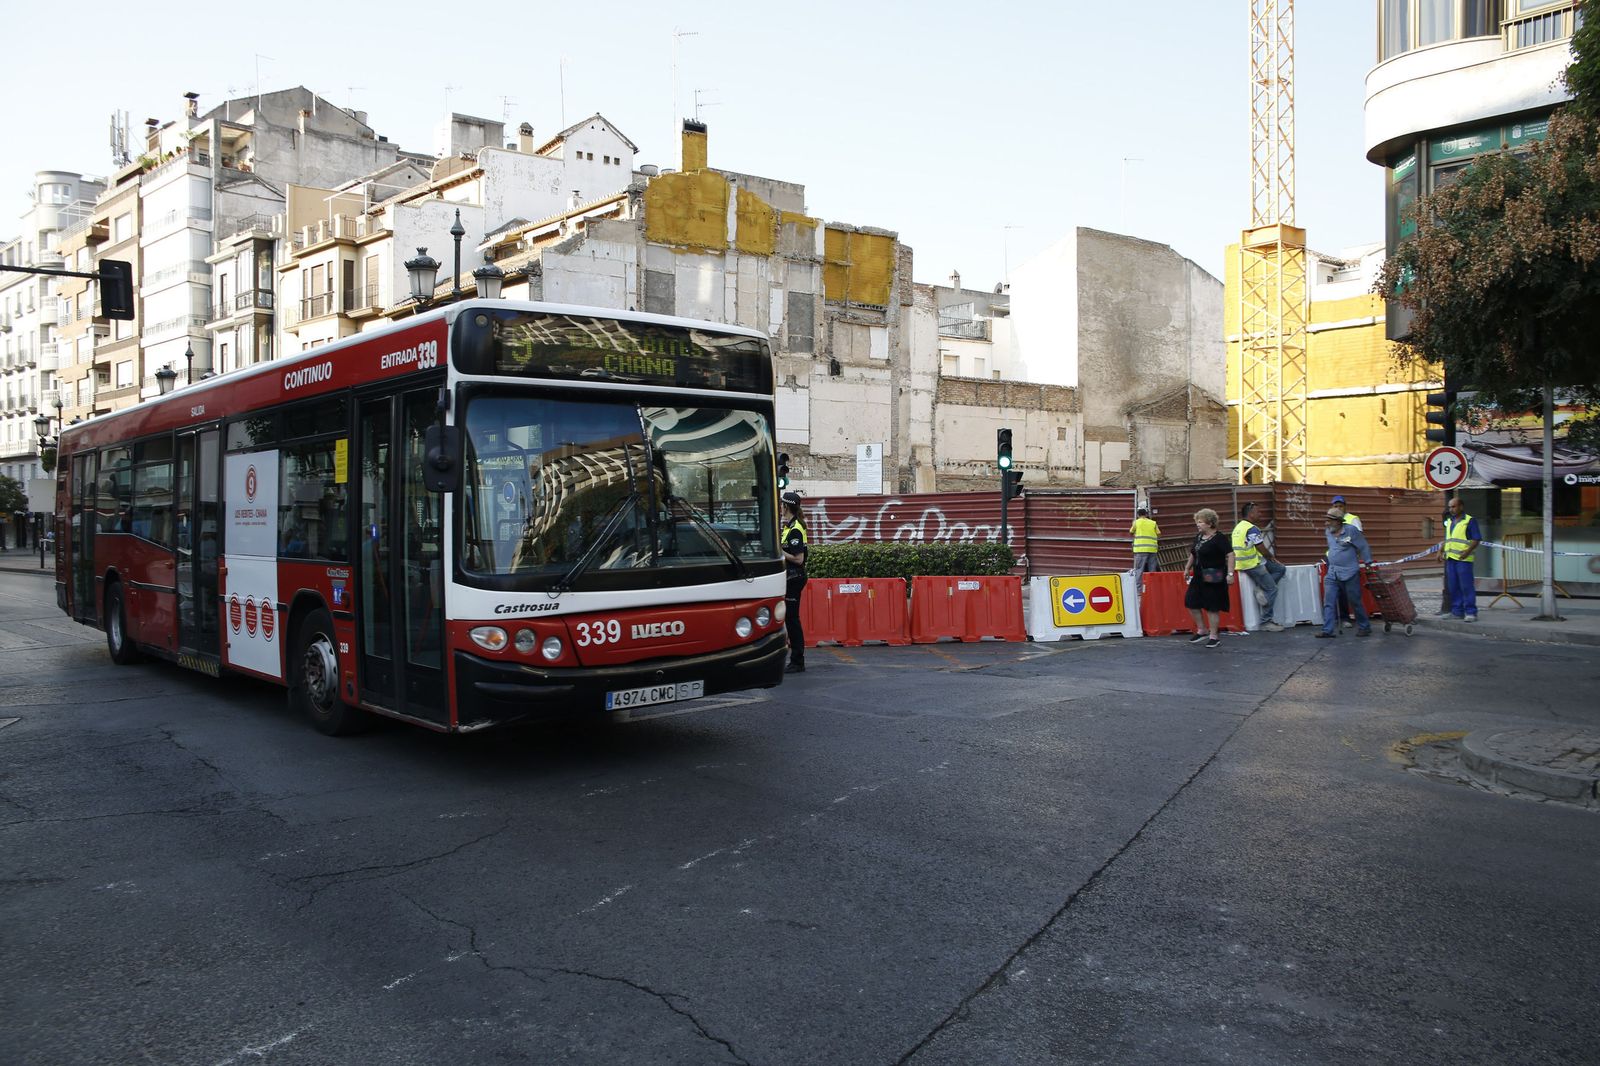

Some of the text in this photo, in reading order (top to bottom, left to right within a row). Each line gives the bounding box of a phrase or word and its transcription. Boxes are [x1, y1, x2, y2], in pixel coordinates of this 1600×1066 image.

[381, 340, 438, 370] ENTRADA 339
[604, 354, 676, 376] CHANA
[284, 361, 333, 390] CONTINUO
[190, 404, 206, 417] SALIDA
[248, 477, 255, 494] 9
[494, 602, 560, 614] Castrosua
[576, 619, 685, 647] 339 IVECO
[340, 642, 349, 654] 339
[614, 691, 647, 706] 4974
[650, 687, 674, 701] CMC
